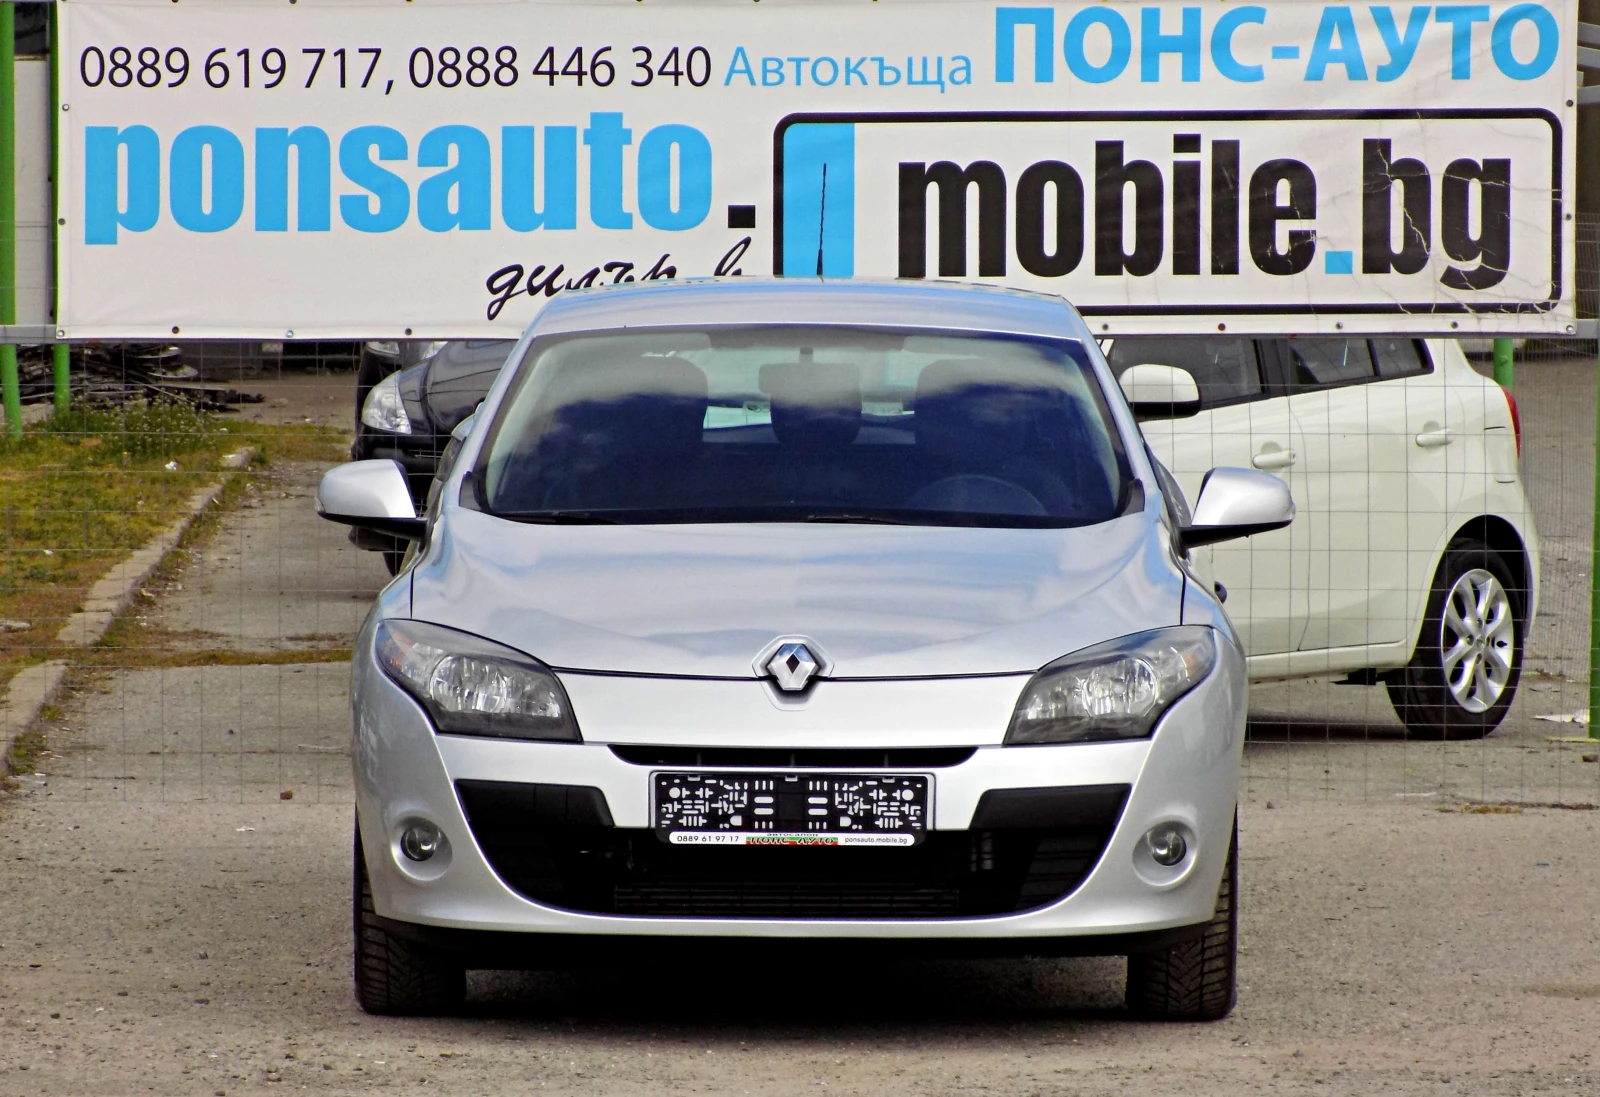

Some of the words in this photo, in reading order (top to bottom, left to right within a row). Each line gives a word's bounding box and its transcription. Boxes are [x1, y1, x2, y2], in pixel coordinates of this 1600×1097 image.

[80, 46, 190, 88] 0889
[204, 47, 288, 89] 619
[302, 48, 395, 96] 717,
[409, 46, 519, 89] 0888
[532, 46, 616, 87] 446
[630, 46, 712, 87] 340
[723, 45, 973, 94] Автокъща
[995, 4, 1560, 84] ПОНС-АУТО
[898, 134, 1511, 290] mobile.bg
[844, 836, 908, 845] ponsauto.mobile.bg
